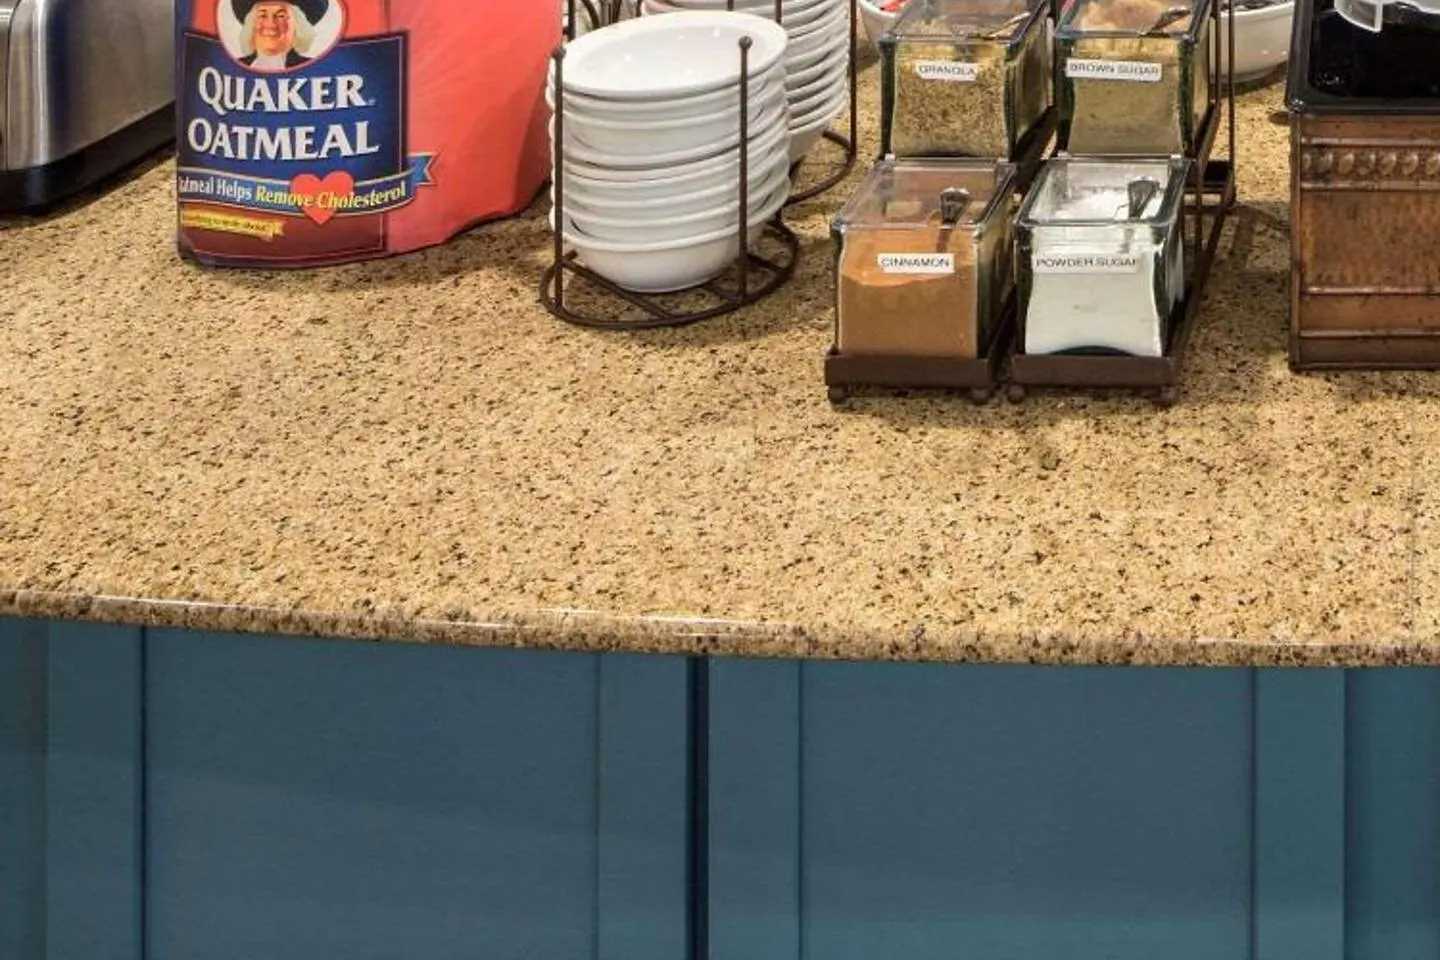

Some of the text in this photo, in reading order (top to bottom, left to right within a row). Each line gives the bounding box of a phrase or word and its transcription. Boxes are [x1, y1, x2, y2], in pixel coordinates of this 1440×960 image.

[918, 64, 976, 76] GRANOLA
[1070, 62, 1159, 76] BROWN SUGAR
[198, 66, 370, 116] QUAKER
[187, 117, 380, 160] OATMEAL
[178, 175, 406, 209] atmeal Helps Remove Cholesterol
[881, 257, 950, 267] CINNAMON
[1036, 257, 1094, 267] POWDER
